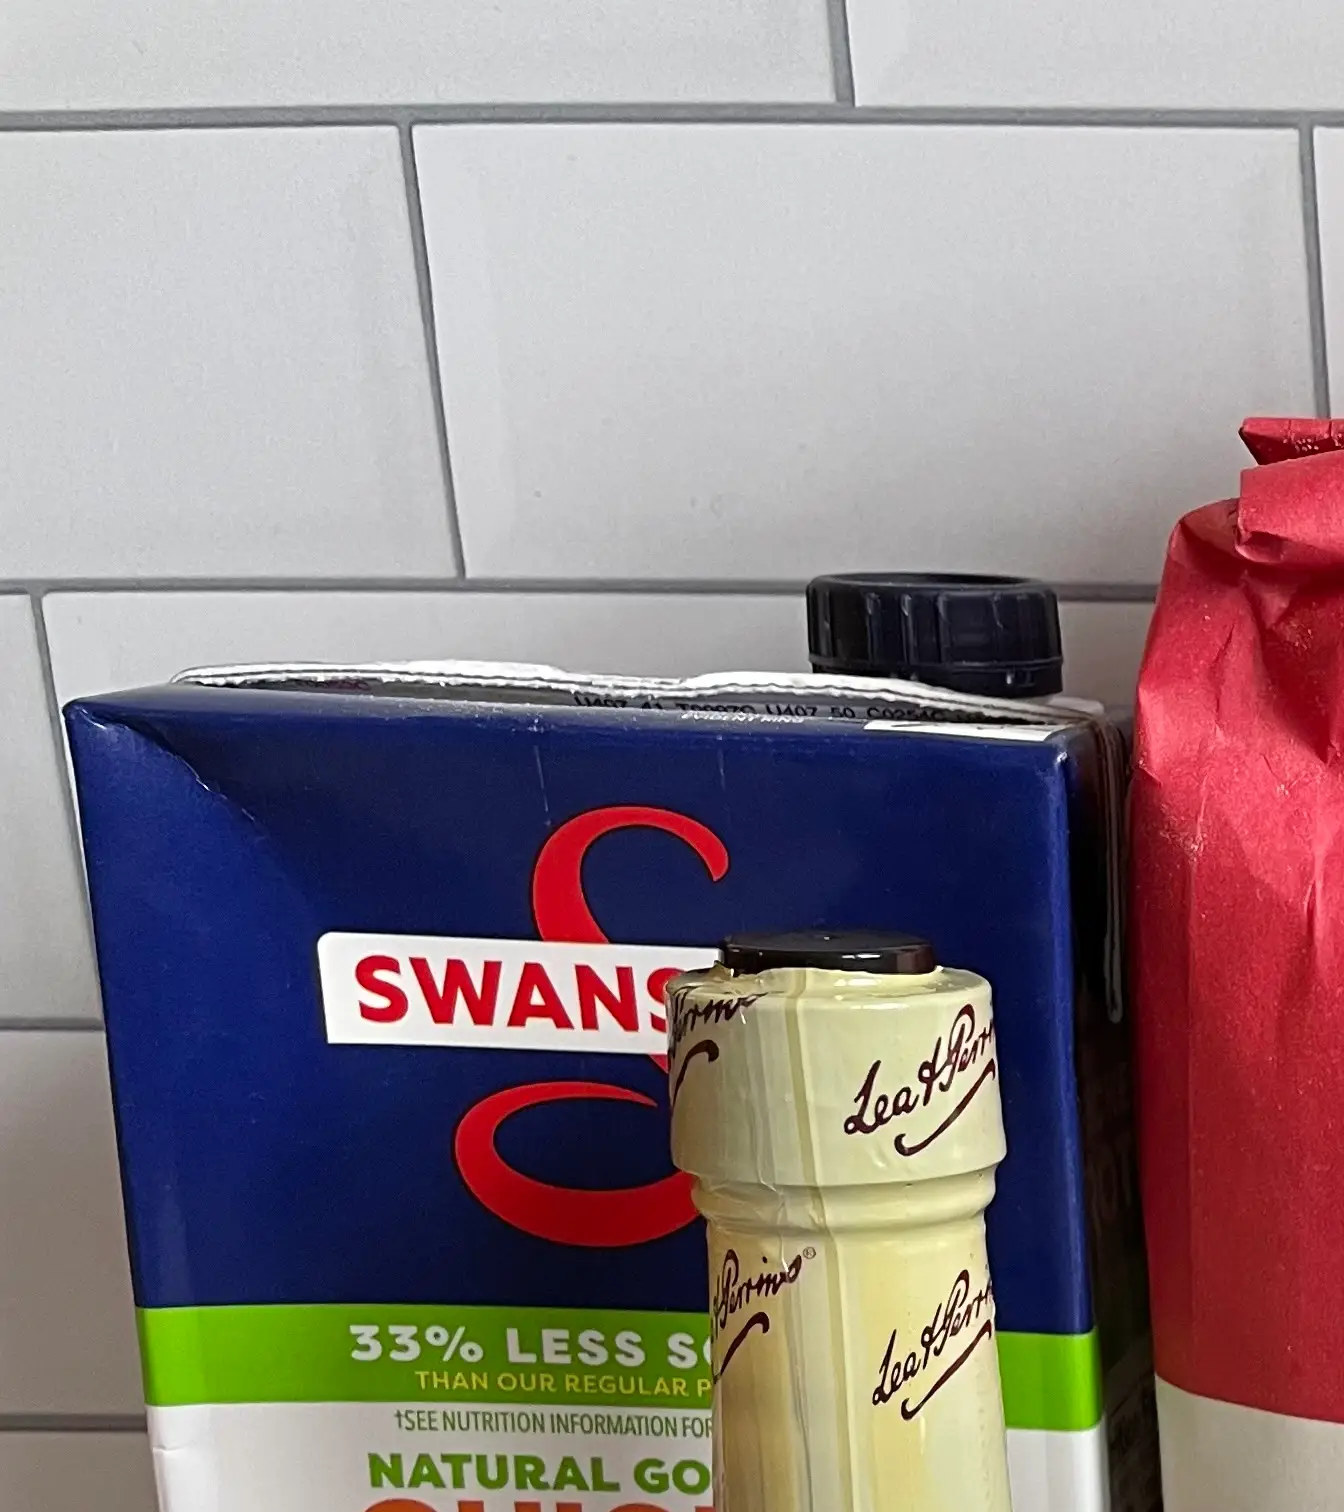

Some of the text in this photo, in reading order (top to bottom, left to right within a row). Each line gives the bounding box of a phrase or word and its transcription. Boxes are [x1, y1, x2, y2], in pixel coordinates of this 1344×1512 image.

[349, 1325, 646, 1368] 33% LESS
[415, 1370, 689, 1398] THAN OUR REGULAR
[443, 1410, 677, 1438] NUTRITION INFORMATION
[367, 1453, 711, 1495] NATURAL GO
